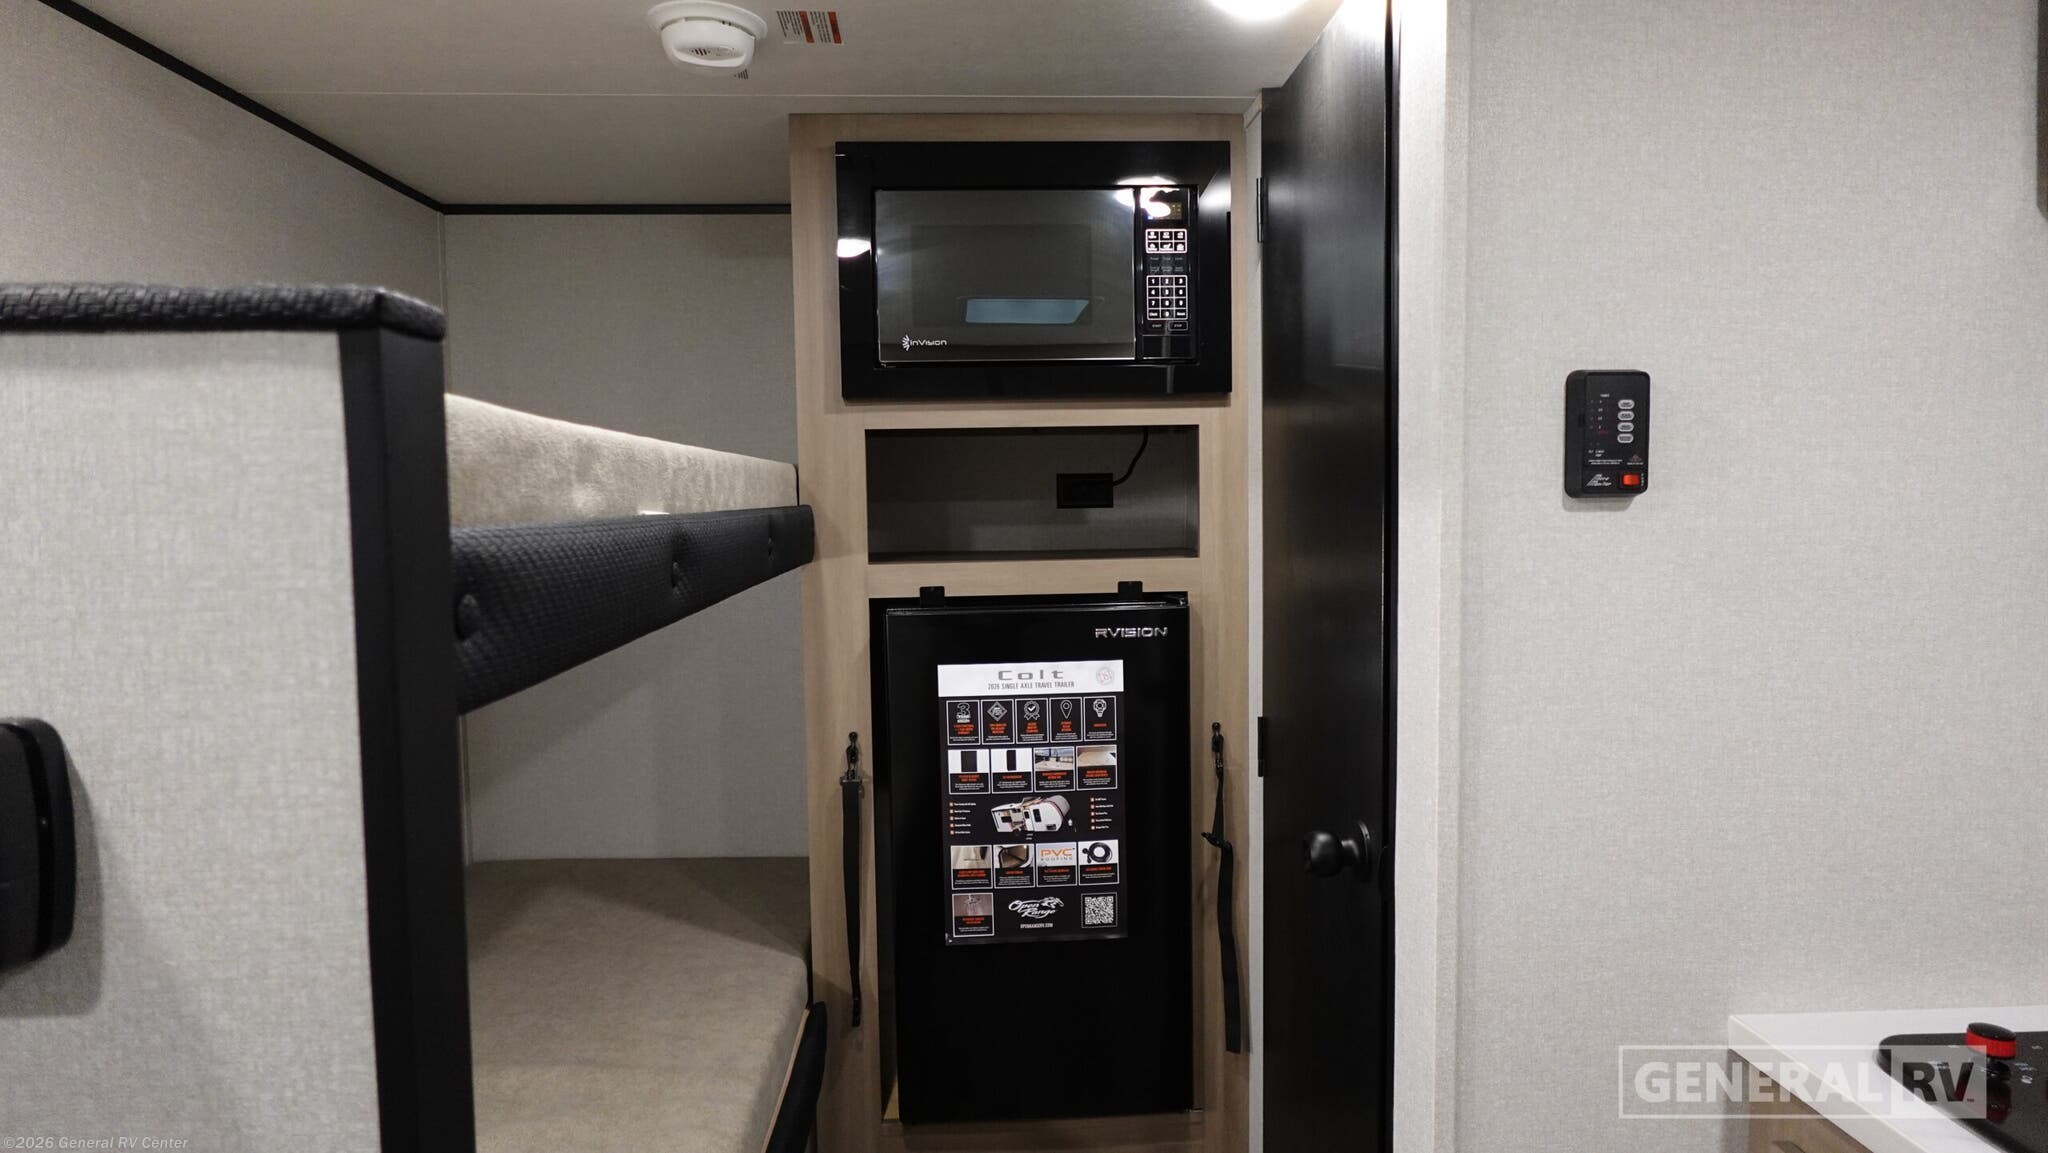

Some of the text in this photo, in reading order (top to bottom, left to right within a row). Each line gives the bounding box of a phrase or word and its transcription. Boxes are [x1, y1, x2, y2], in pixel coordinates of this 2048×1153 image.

[1095, 627, 1168, 639] RVISION
[998, 669, 1064, 681] Colt
[1001, 682, 1019, 690] SINGLE
[1035, 681, 1053, 689] TRAVEL
[1054, 680, 1075, 688] TRAILER
[1040, 849, 1073, 857] PVC
[1008, 900, 1040, 913] Open
